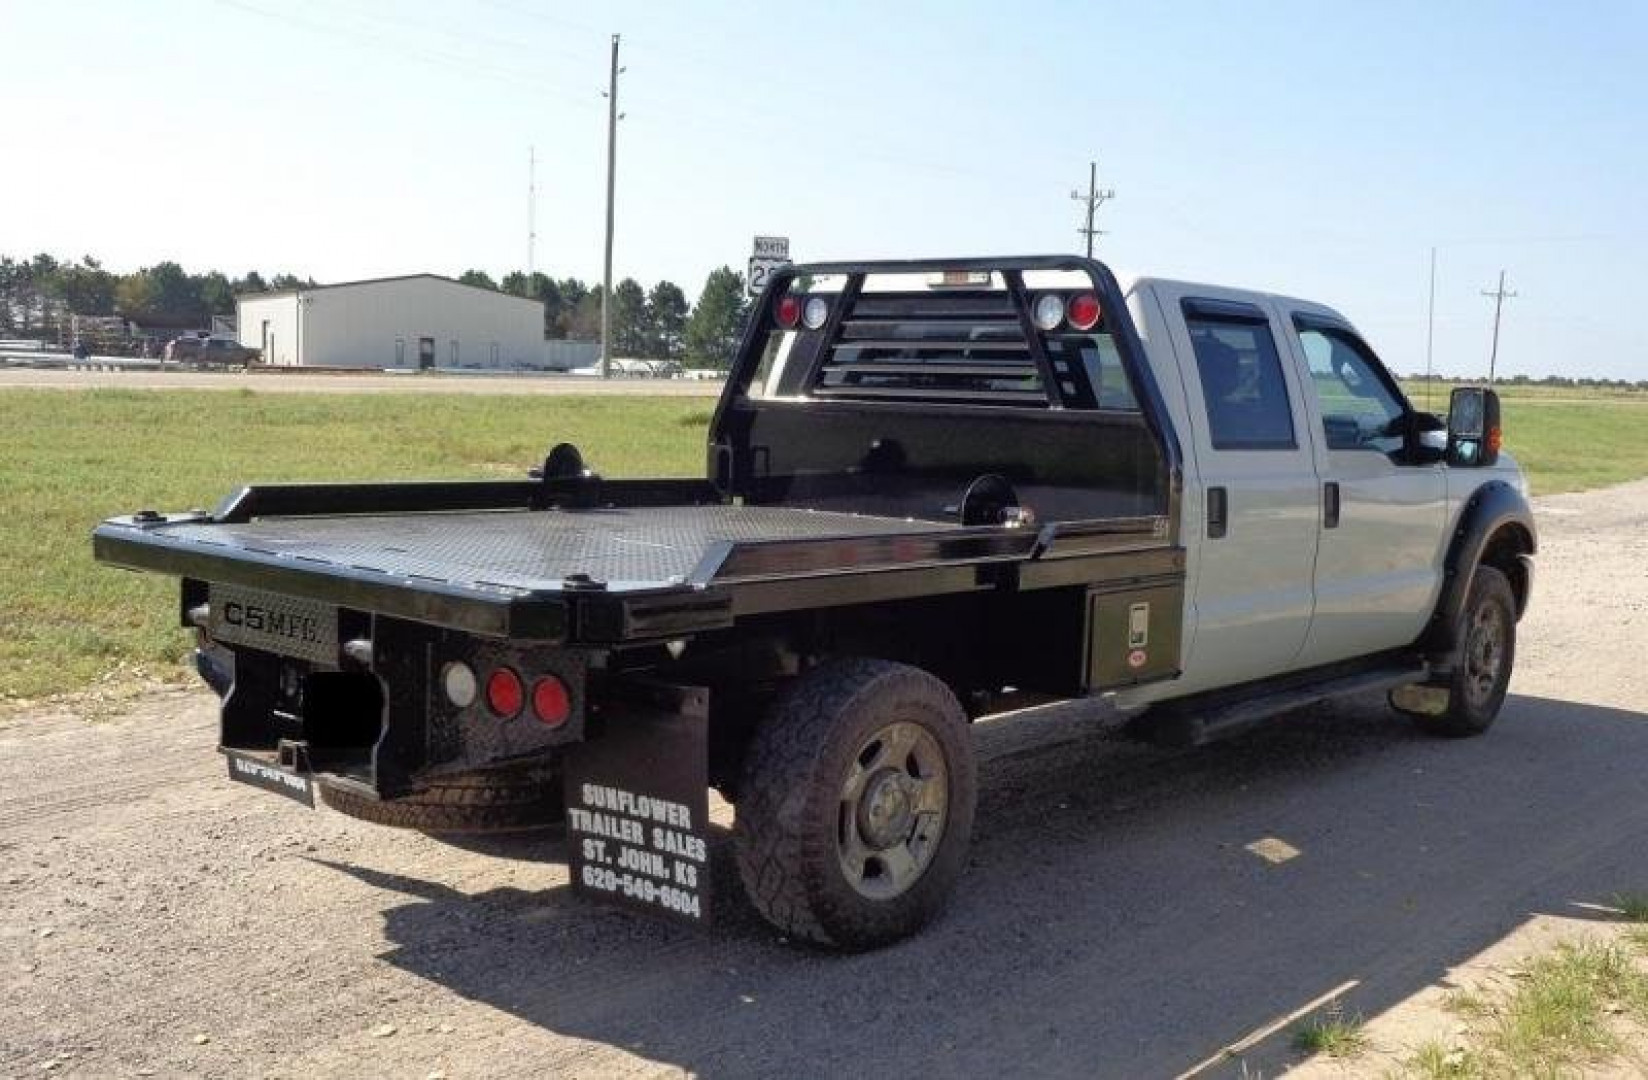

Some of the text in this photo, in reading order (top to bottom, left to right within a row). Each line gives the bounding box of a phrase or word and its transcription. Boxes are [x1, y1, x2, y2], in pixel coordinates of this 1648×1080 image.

[755, 239, 788, 254] NORTH
[582, 783, 691, 829] SUNFLOWER
[568, 807, 706, 862] TRAILER SALES
[582, 838, 613, 865] ST.
[675, 860, 697, 888] KS
